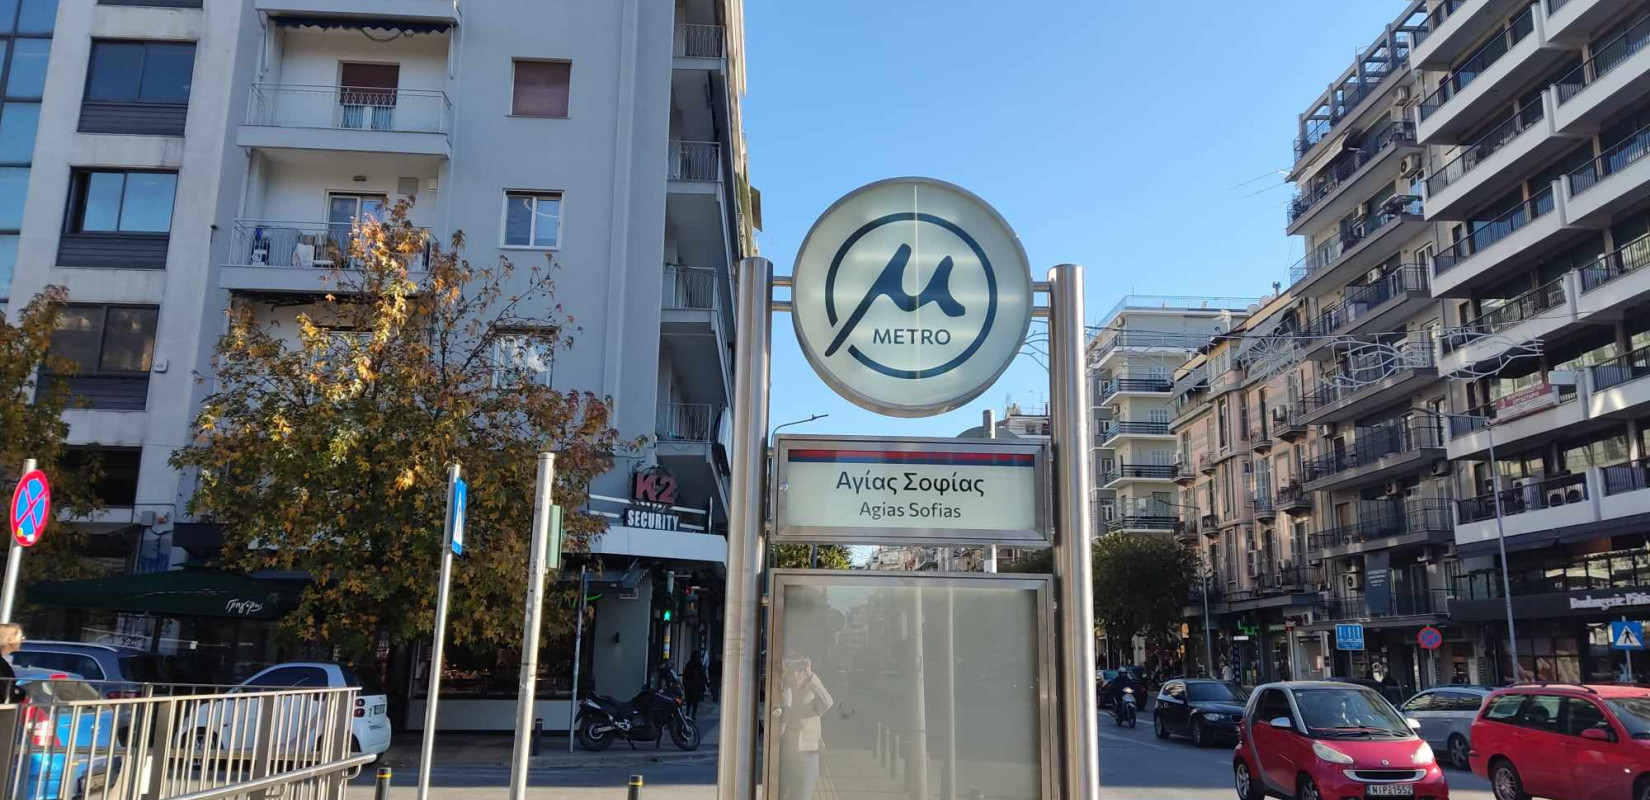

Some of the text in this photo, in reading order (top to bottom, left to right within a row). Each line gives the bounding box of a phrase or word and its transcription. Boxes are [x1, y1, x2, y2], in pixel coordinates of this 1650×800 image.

[872, 328, 951, 345] METRO
[835, 470, 985, 497] Αγίας Σοφίας
[627, 509, 679, 531] SECURITY
[859, 501, 962, 520] Agias Sofias
